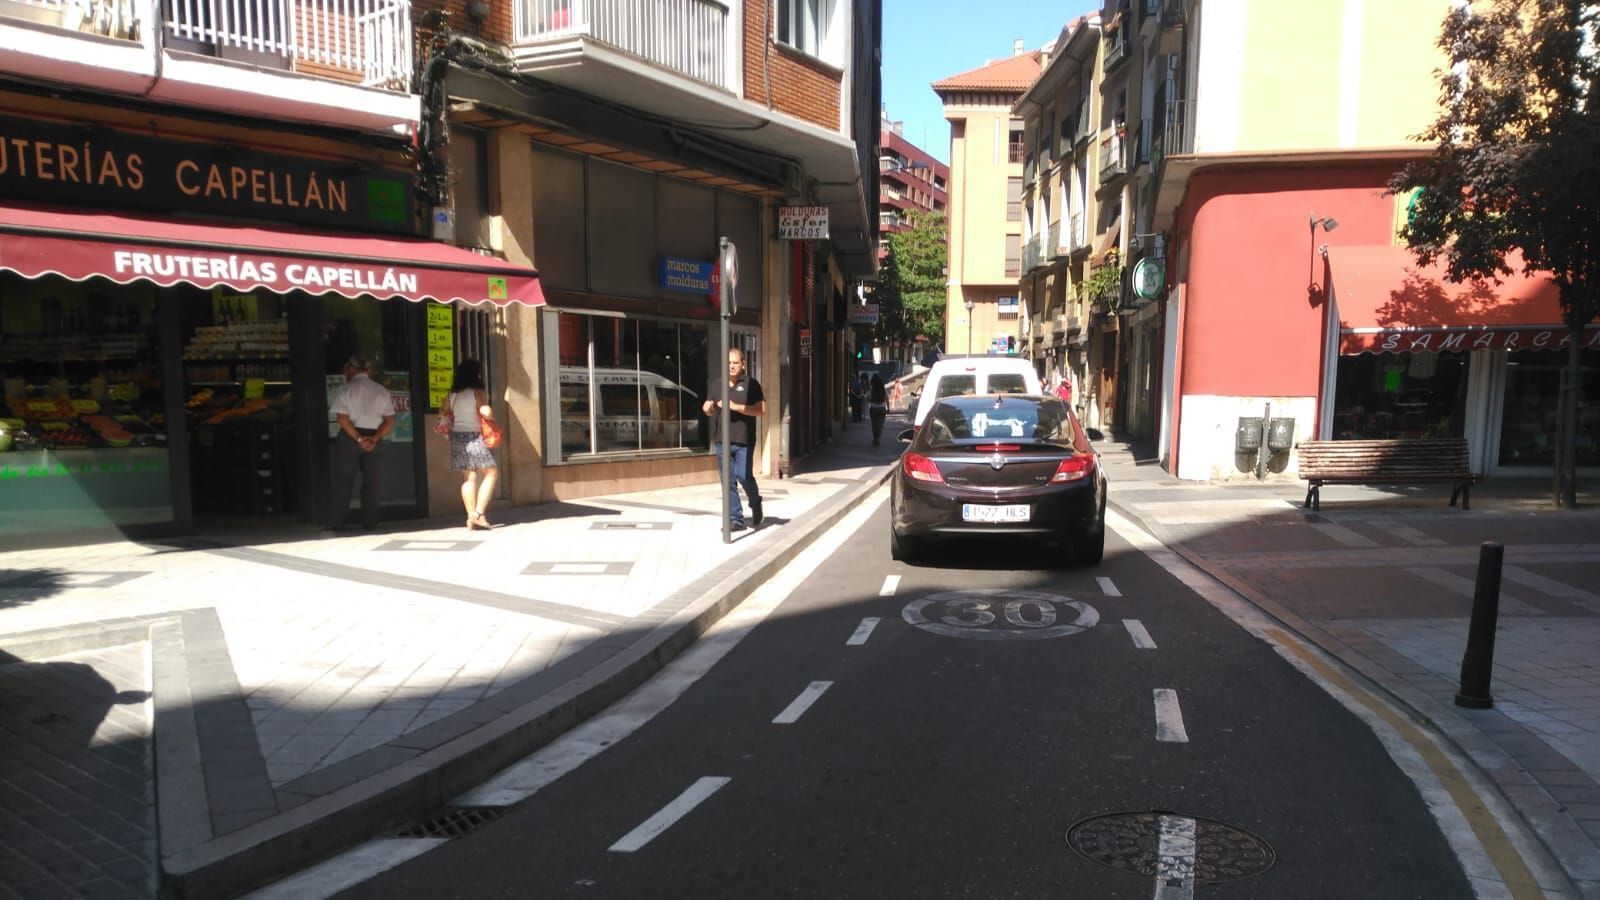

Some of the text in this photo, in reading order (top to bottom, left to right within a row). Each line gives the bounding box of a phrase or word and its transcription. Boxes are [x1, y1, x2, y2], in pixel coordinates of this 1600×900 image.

[176, 159, 347, 212] CAPELLÁN
[780, 207, 826, 217] MOLDURAS
[780, 228, 820, 238] MARCOS
[114, 251, 417, 293] FRUTERÍAS CAPELLÁN
[667, 260, 699, 273] marcos
[667, 274, 709, 289] molduras
[941, 600, 1057, 628] 30
